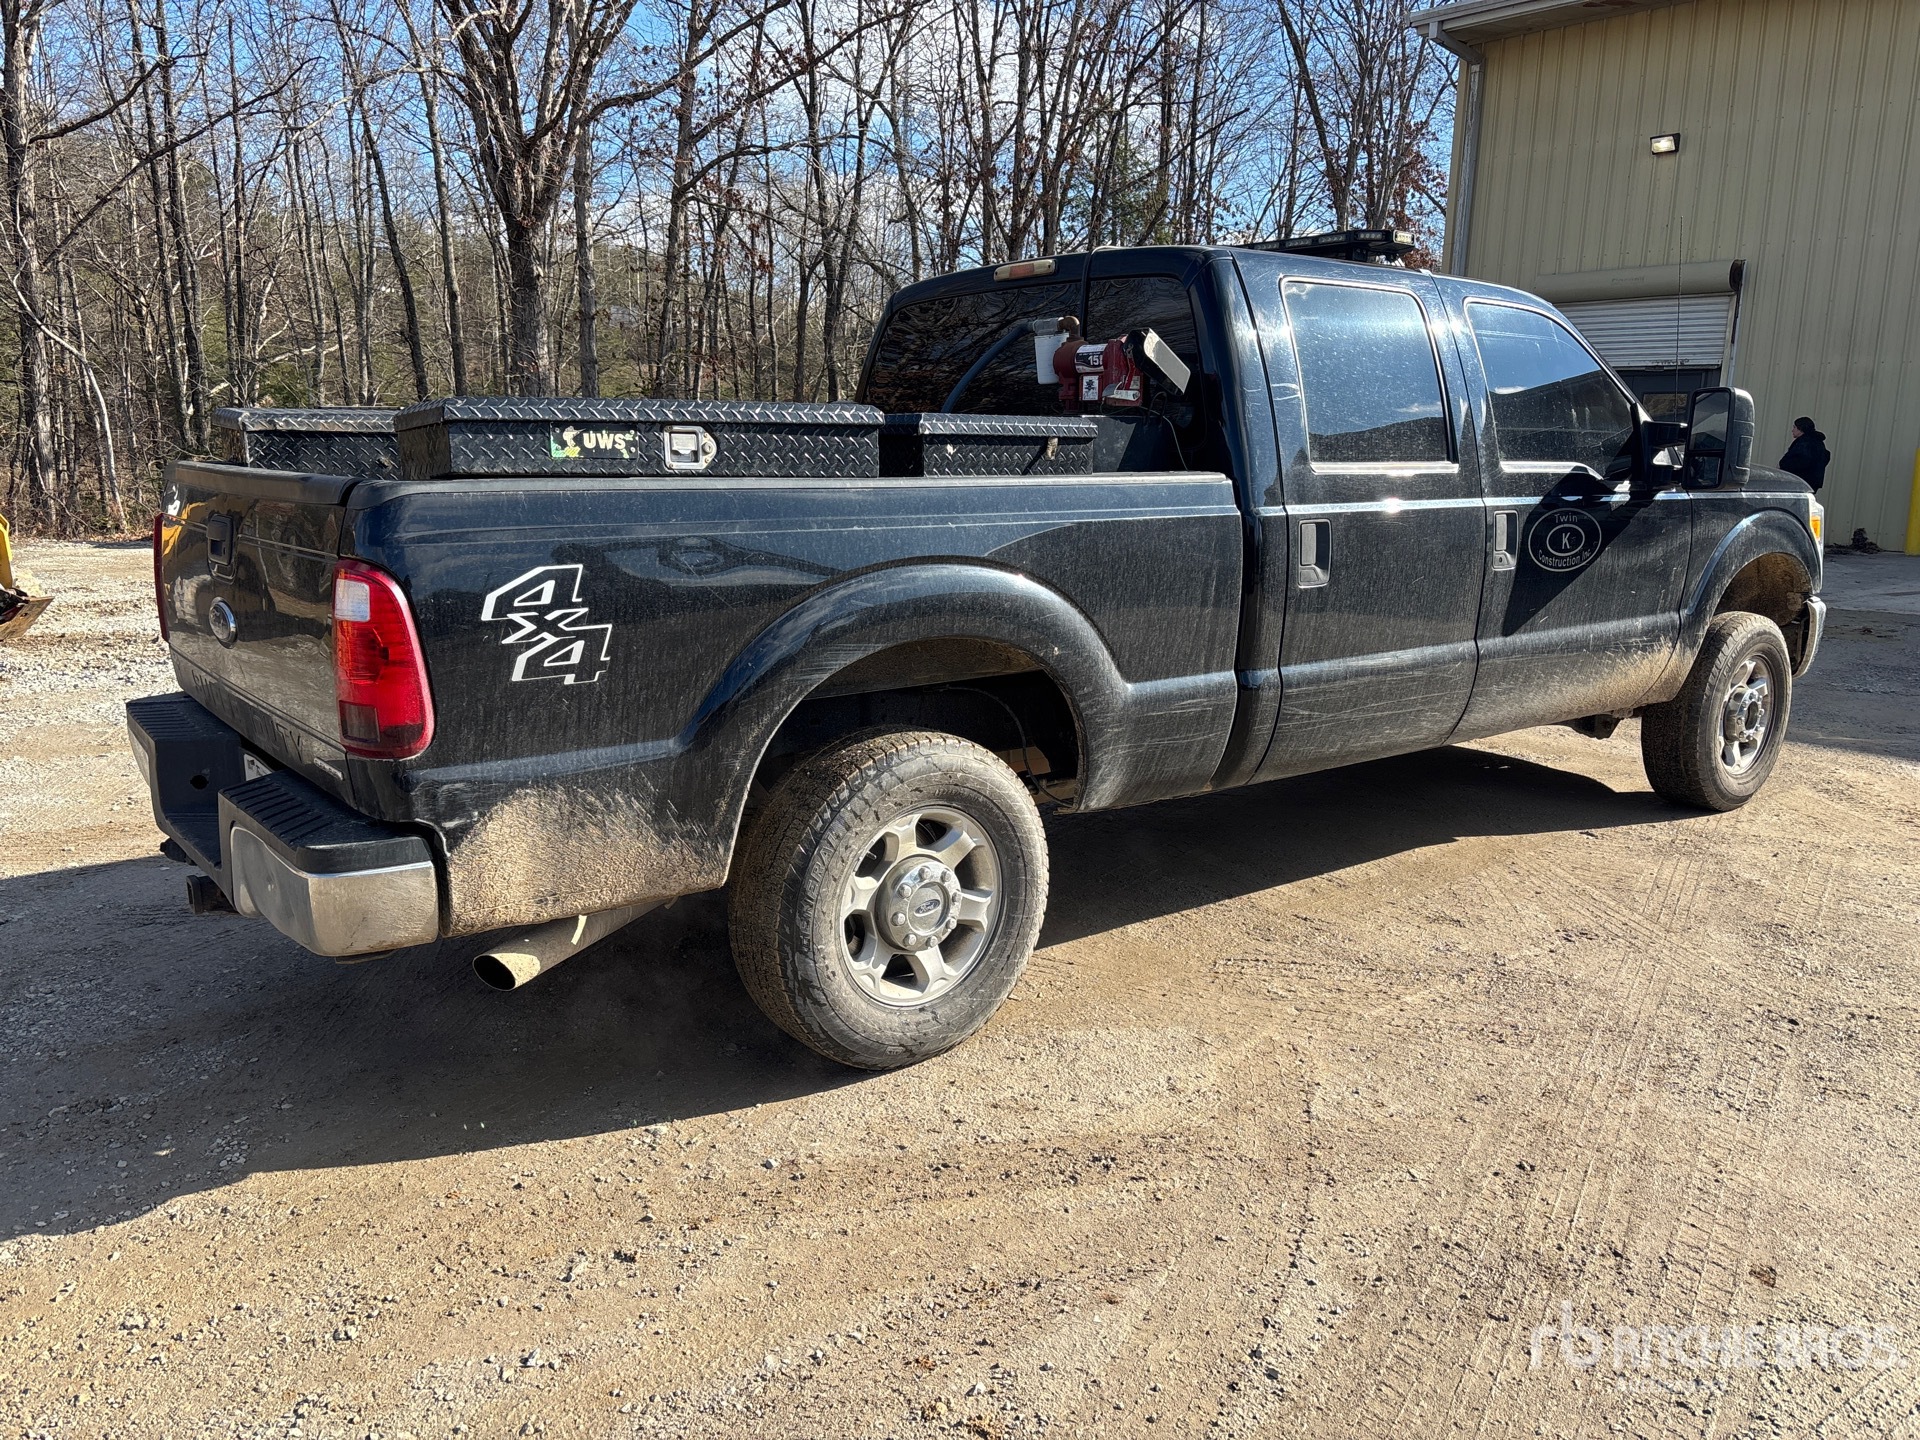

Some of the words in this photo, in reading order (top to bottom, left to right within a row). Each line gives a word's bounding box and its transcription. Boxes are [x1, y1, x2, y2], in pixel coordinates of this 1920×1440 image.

[582, 432, 627, 450] UWS
[1554, 512, 1578, 523] Twin
[1562, 532, 1571, 550] K
[1538, 549, 1581, 567] Construction
